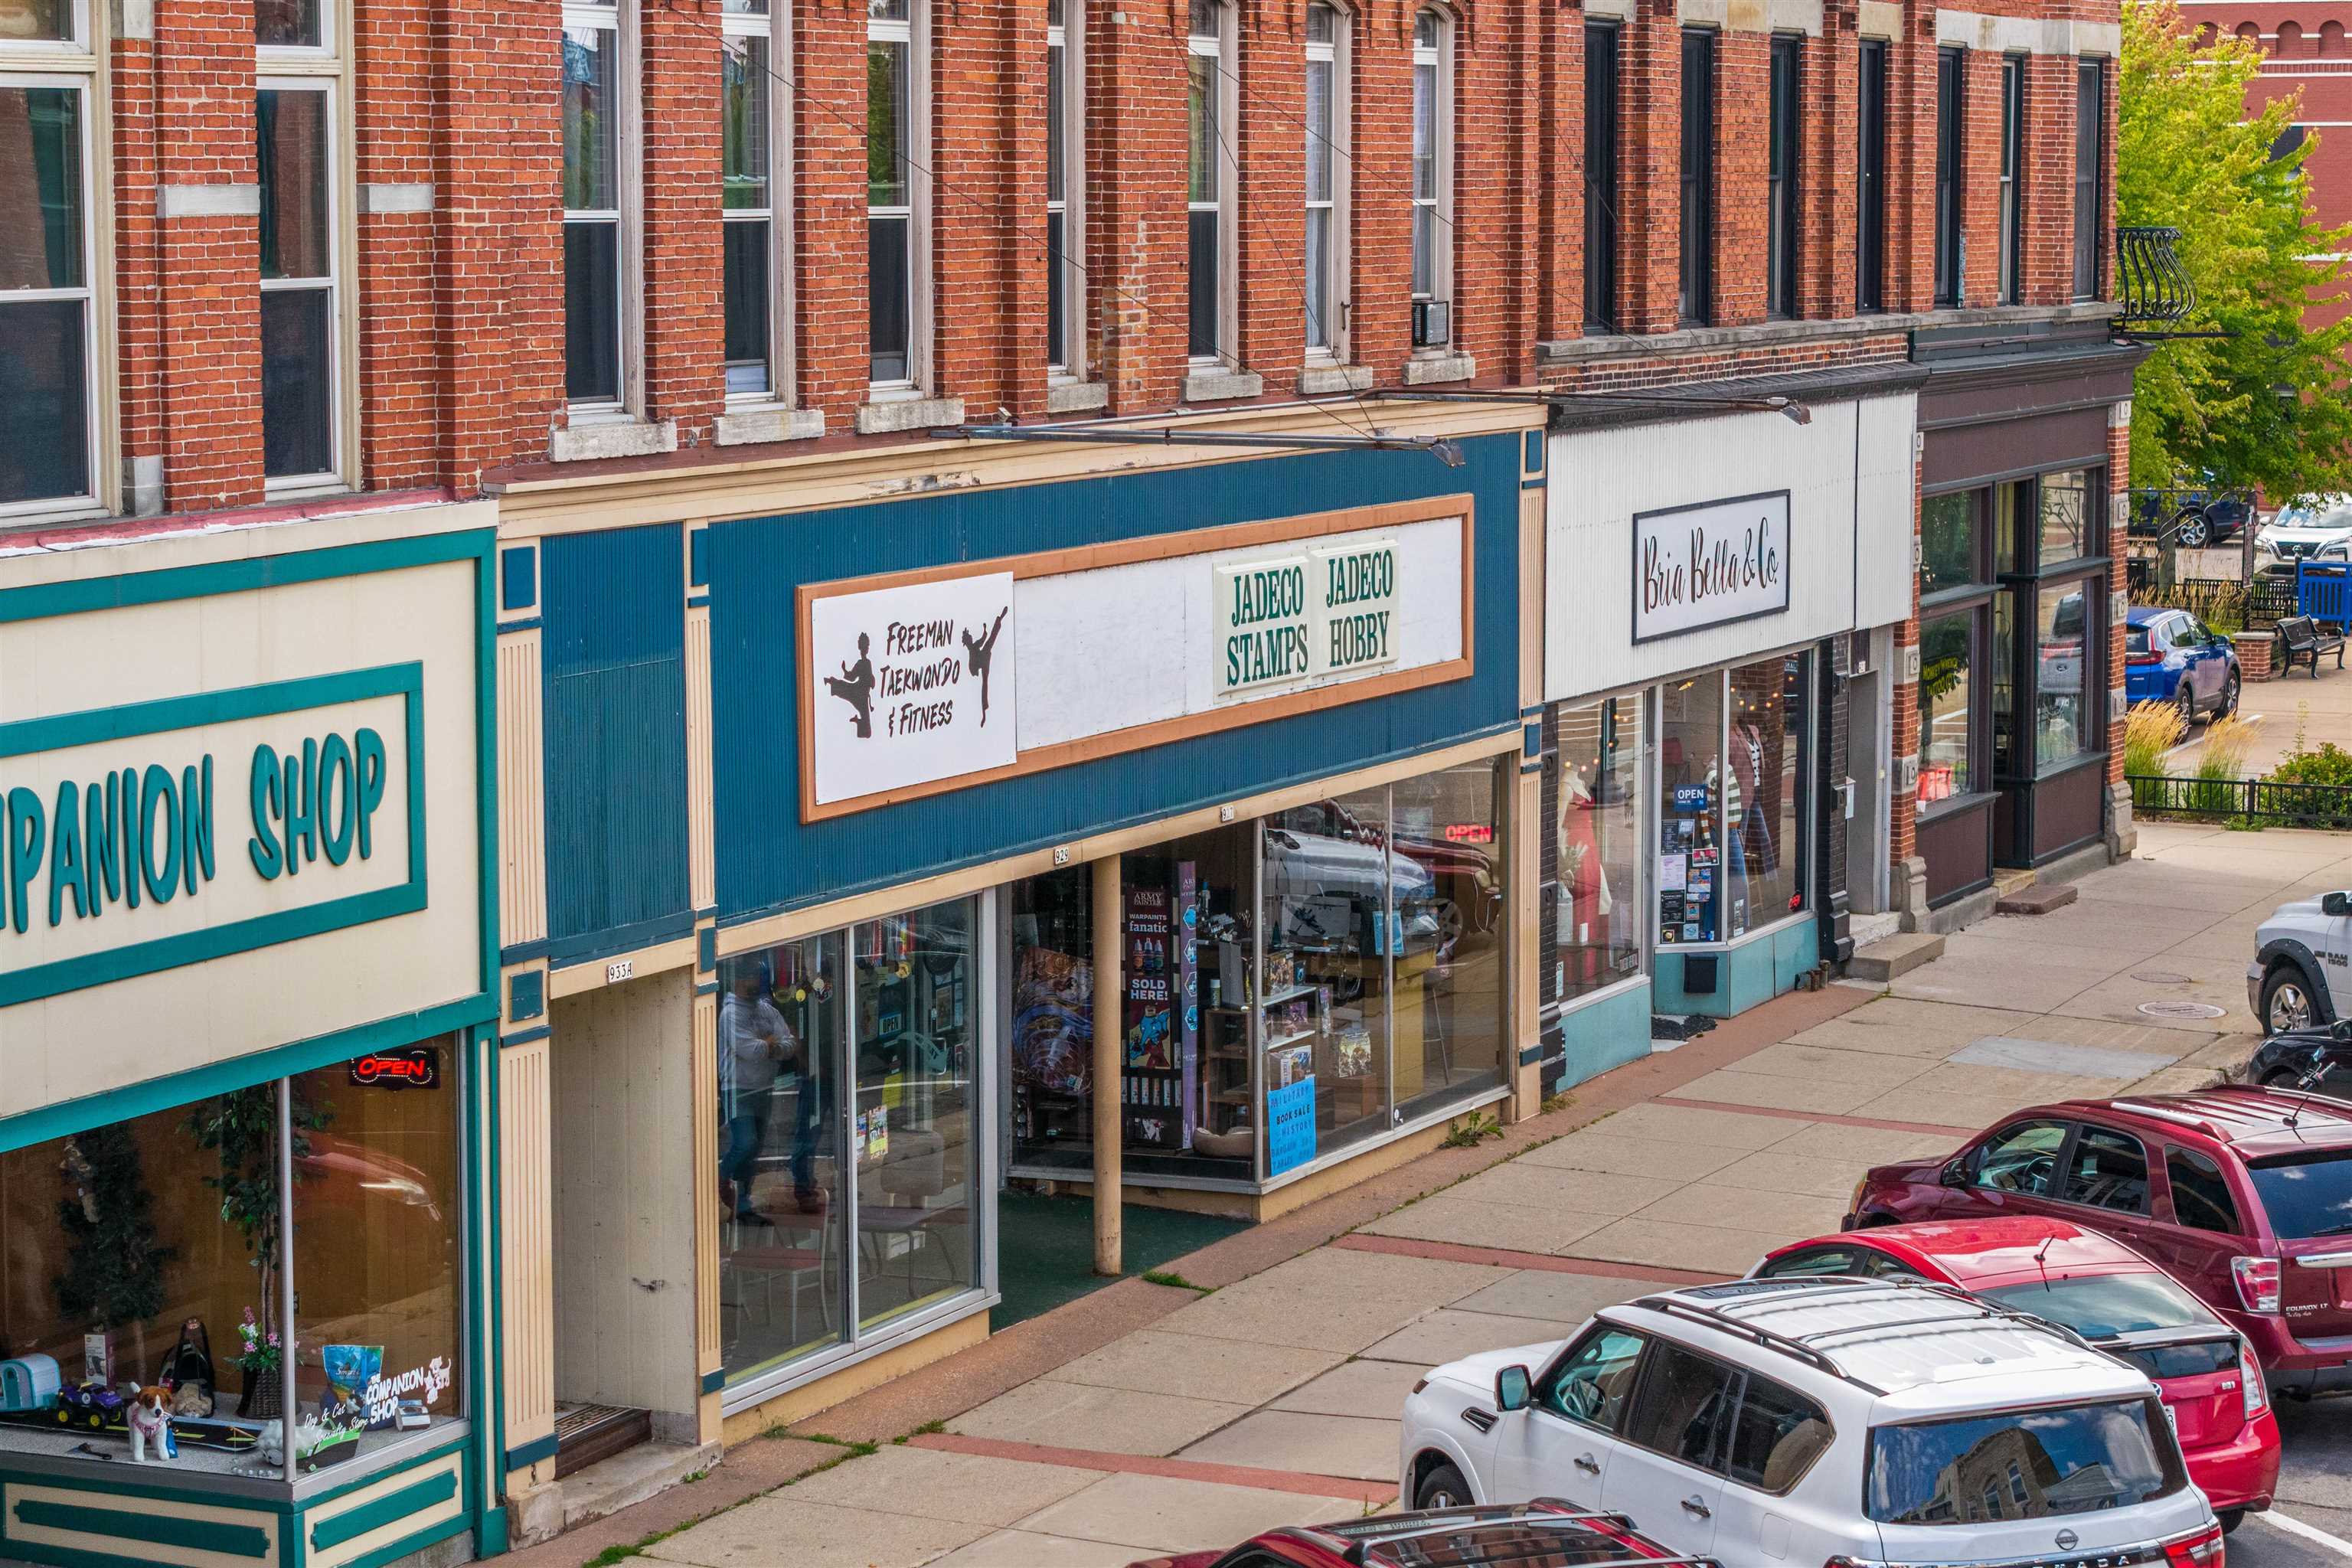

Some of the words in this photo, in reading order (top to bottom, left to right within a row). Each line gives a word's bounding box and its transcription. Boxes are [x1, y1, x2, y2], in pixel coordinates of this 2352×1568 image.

[1644, 536, 1686, 614] Bria
[1690, 527, 1740, 603] Bella
[1743, 528, 1756, 586] &
[1758, 517, 1779, 589] Co.
[1326, 549, 1393, 608] JADECO
[1231, 566, 1303, 627] JADECO
[887, 619, 954, 656] FREEMAN
[1328, 610, 1390, 668] HOBBY
[1227, 623, 1308, 686] STAMPS
[880, 656, 961, 699] TAEKWONDO
[888, 707, 896, 737] &
[899, 700, 953, 735] FITNESS
[1677, 789, 1704, 799] OPEN
[0, 753, 216, 935] PANION
[248, 727, 387, 880] SHOP
[1445, 824, 1492, 843] OPEN
[1056, 848, 1069, 863] 929
[1134, 892, 1161, 900] ARMY
[1129, 921, 1168, 933] fanatic
[2328, 952, 2348, 962] RAM
[2328, 959, 2348, 967] 1500
[609, 962, 632, 980] 933A
[1130, 990, 1168, 1001] HERE!
[1132, 978, 1166, 989] SOLD
[358, 1057, 426, 1076] OPEN
[1276, 1112, 1293, 1125] BOOK
[1294, 1104, 1311, 1119] SALE
[366, 1366, 425, 1405] COMPANION
[304, 1413, 318, 1430] Dog
[321, 1407, 329, 1420] &
[332, 1402, 346, 1417] Cat
[369, 1396, 399, 1424] SHOP
